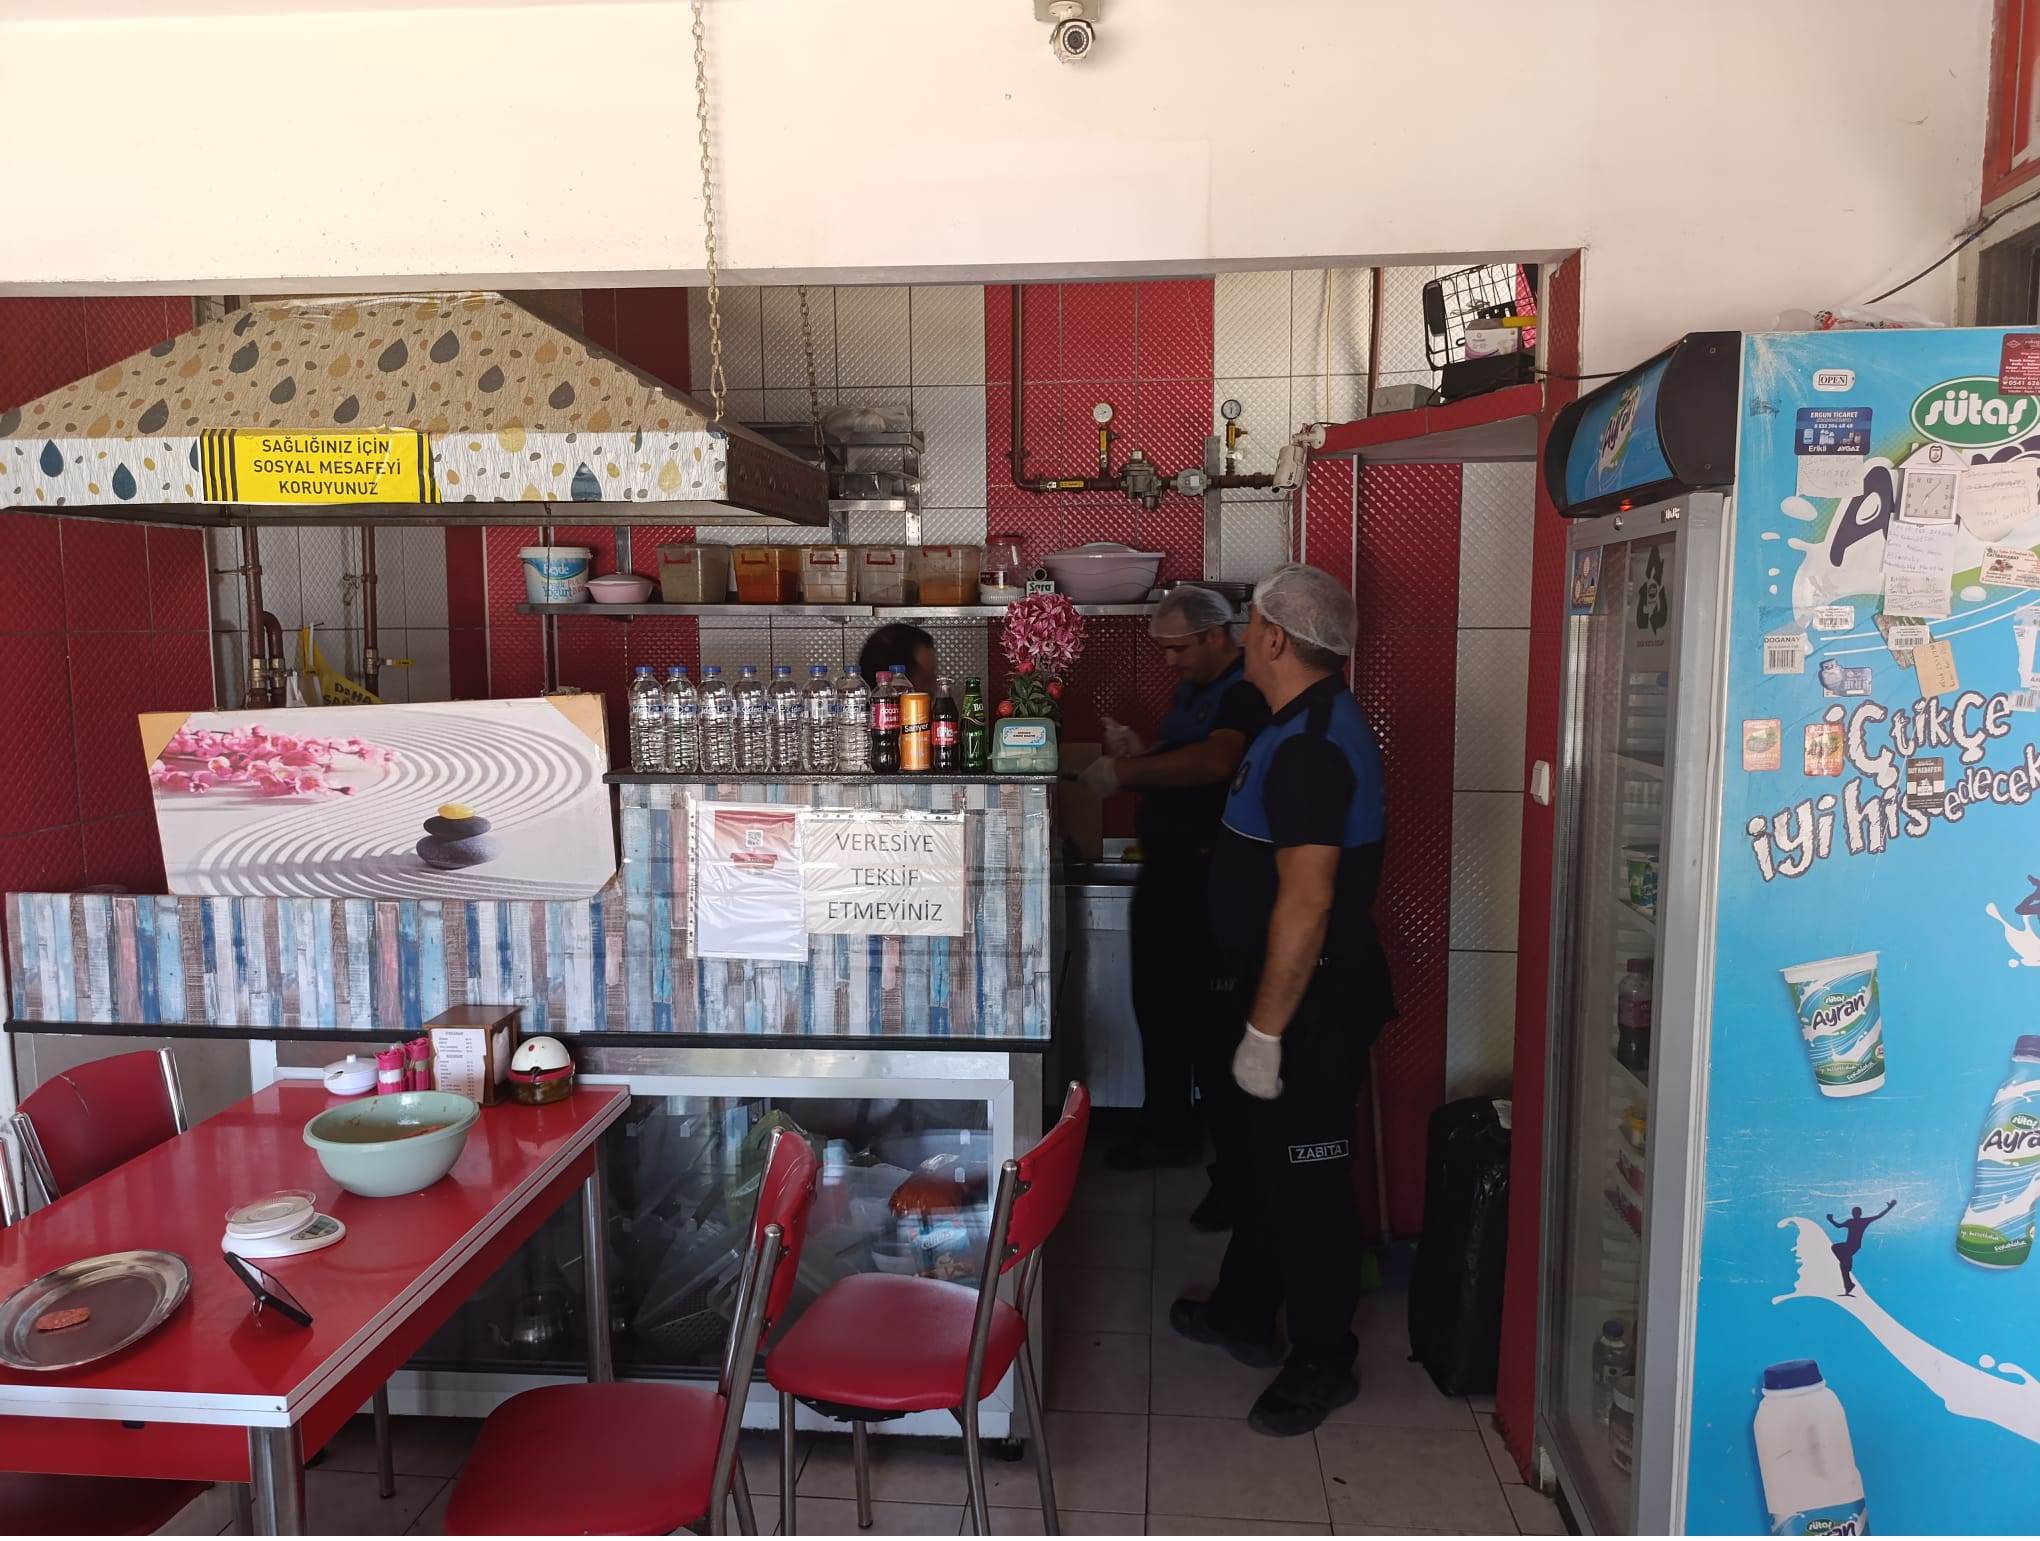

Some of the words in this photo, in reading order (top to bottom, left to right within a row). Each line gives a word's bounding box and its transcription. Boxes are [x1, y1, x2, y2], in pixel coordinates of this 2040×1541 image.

[1820, 376, 1846, 384] OPEN
[1924, 389, 2028, 435] sütaş
[262, 437, 352, 454] SAĞLIĞINIZ
[357, 437, 389, 455] İÇİN
[254, 460, 315, 474] SOSYAL
[320, 459, 401, 475] MESAFEYİ
[279, 481, 379, 495] KORUYUNUZ
[1029, 583, 1051, 592] Sara
[836, 831, 934, 853] VERESİYE
[850, 864, 919, 887] TEKLİF
[828, 899, 943, 922] ETMEYİNİZ
[1812, 993, 1866, 1031] Ayran
[1296, 1142, 1343, 1160] ZABITA
